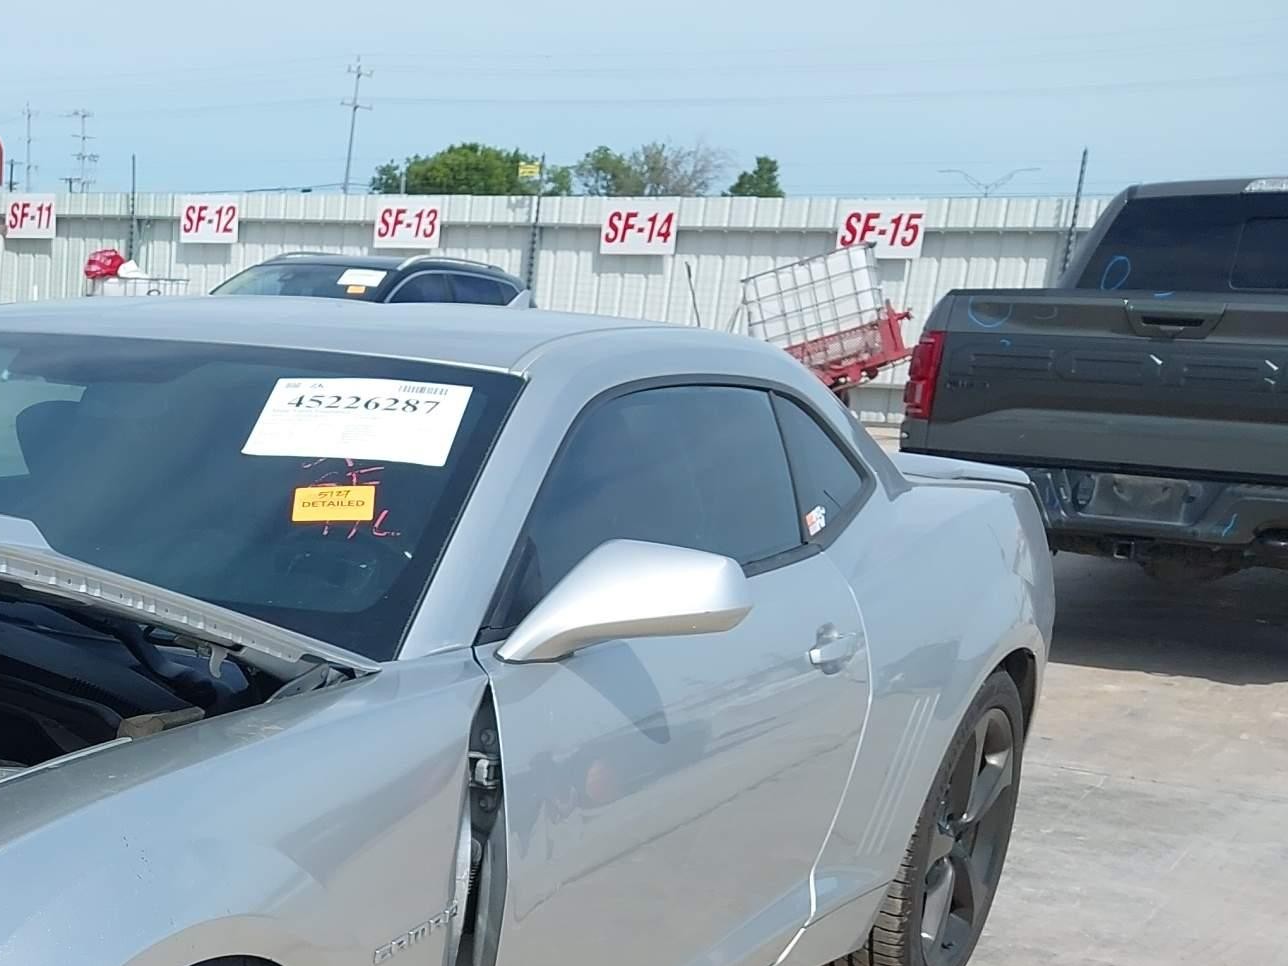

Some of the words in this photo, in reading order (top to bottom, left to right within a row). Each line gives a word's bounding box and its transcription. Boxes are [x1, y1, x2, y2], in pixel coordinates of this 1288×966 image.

[9, 202, 53, 229] SF-11
[183, 205, 236, 233] SF-12
[377, 208, 438, 238] SF-13
[604, 211, 674, 243] SF-14
[840, 212, 923, 246] SF-15
[287, 395, 440, 415] 45226287
[302, 500, 366, 509] DETAILED
